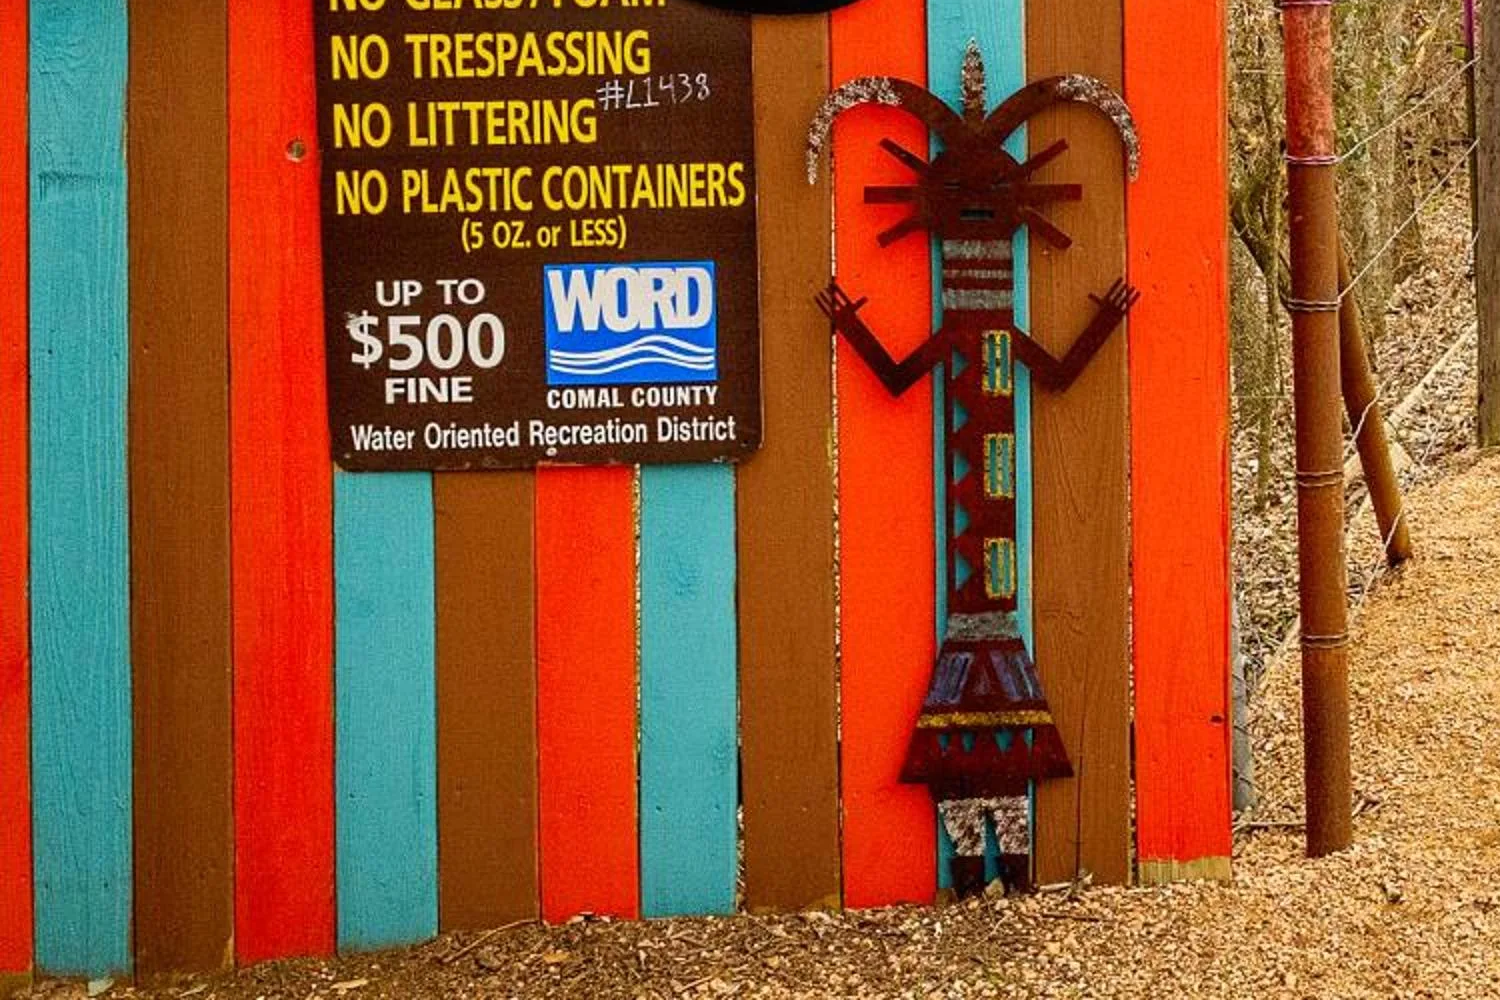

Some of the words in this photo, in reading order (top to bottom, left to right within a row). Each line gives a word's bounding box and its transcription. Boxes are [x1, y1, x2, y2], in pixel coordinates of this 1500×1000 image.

[331, 35, 390, 80] NO
[404, 30, 652, 78] TRESPASSING
[334, 102, 392, 149] NO
[408, 98, 599, 147] LITTERING
[336, 169, 389, 215] NO
[402, 166, 533, 213] PLASTIC
[541, 162, 747, 210] CONTAINERS
[461, 217, 484, 253] (5
[493, 222, 532, 248] OZ.
[537, 224, 561, 248] or
[570, 215, 628, 250] LESS)
[375, 279, 424, 307] UP
[436, 278, 486, 305] TO
[547, 266, 714, 333] WORD
[346, 310, 506, 370] $500
[384, 376, 474, 404] FINE
[546, 388, 624, 410] COMAL
[631, 385, 719, 408] COUNTY
[350, 424, 415, 452] Water
[423, 420, 520, 449] Oriented
[529, 418, 648, 446] Recreation
[656, 413, 737, 443] District
